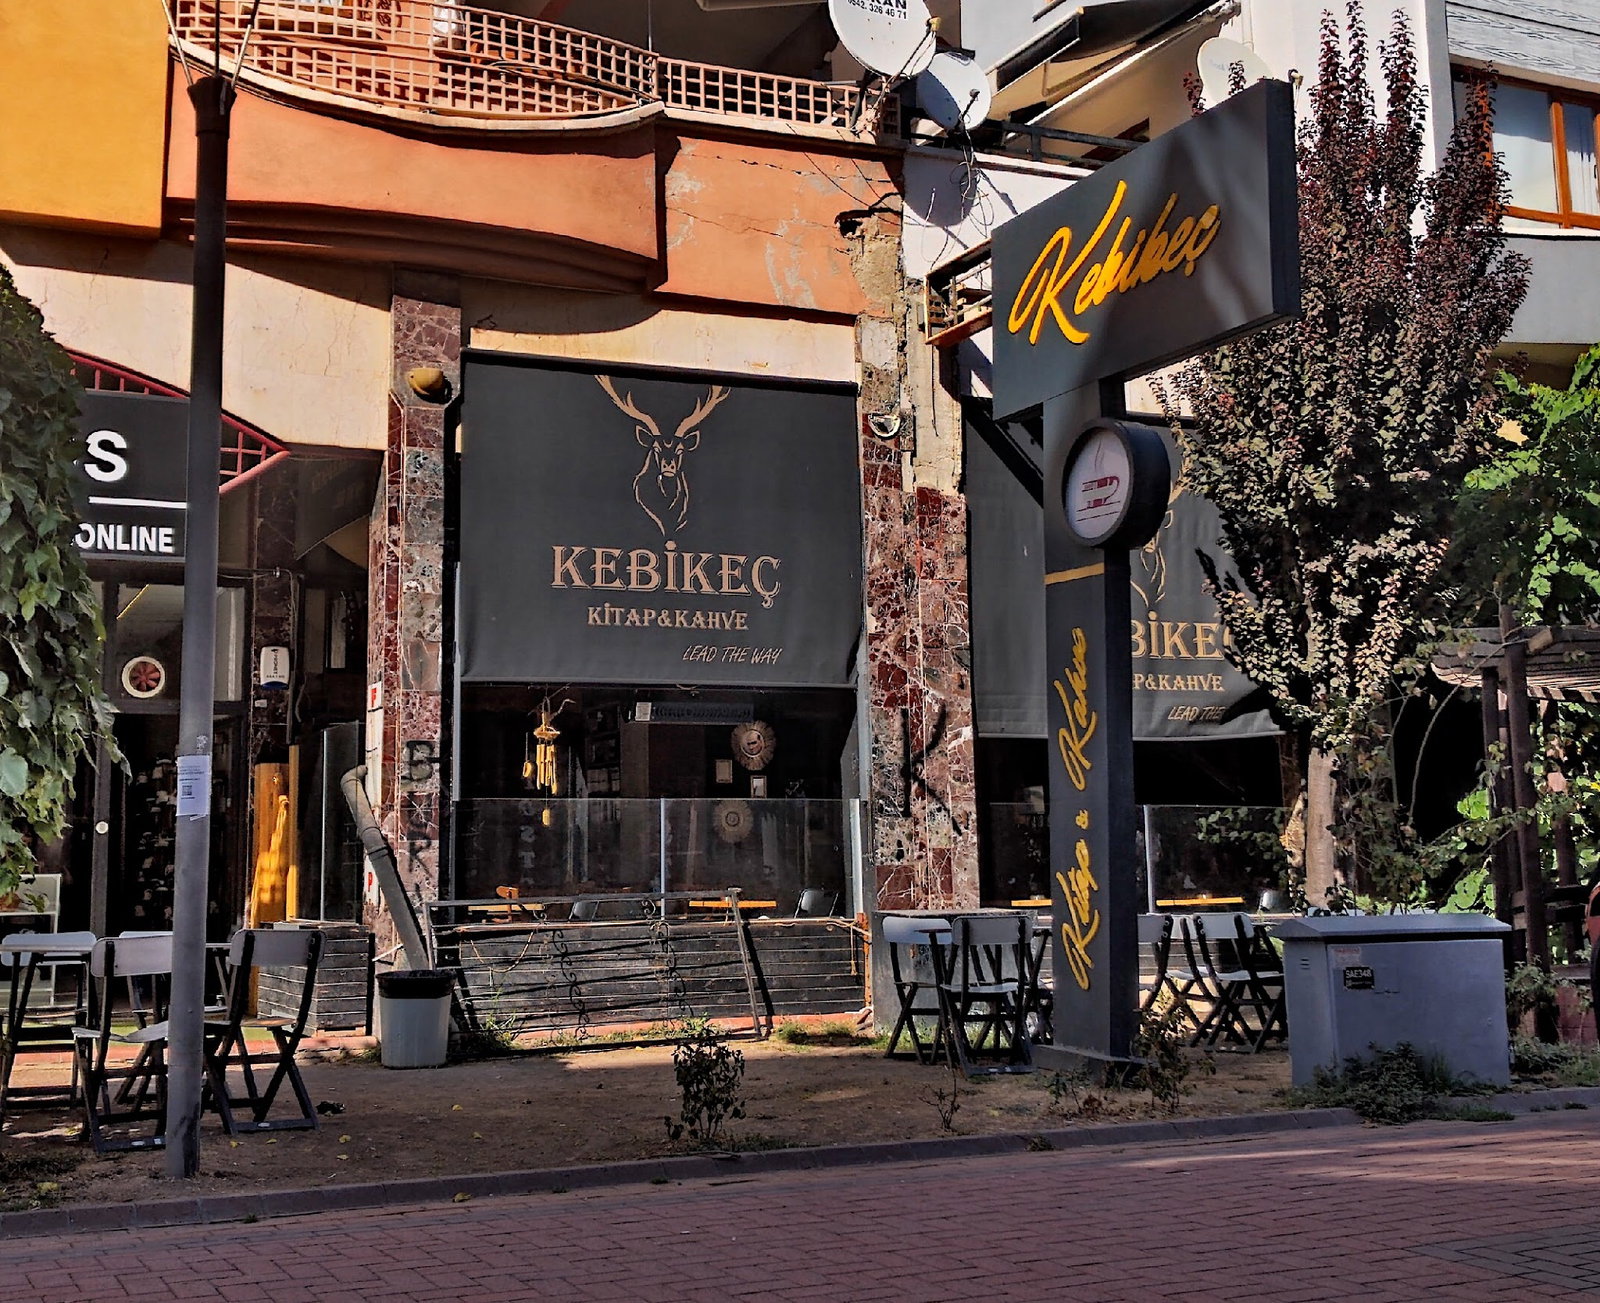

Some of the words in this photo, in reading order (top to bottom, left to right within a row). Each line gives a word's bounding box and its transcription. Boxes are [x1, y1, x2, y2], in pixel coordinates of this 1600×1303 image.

[869, 3, 883, 15] 326
[897, 10, 907, 20] 71
[75, 523, 174, 553] ONLINE
[550, 540, 782, 609] KEBİKEÇ
[682, 645, 718, 663] LEAD
[721, 646, 749, 663] THE
[751, 648, 783, 665] WAY
[1168, 705, 1199, 721] LEAD
